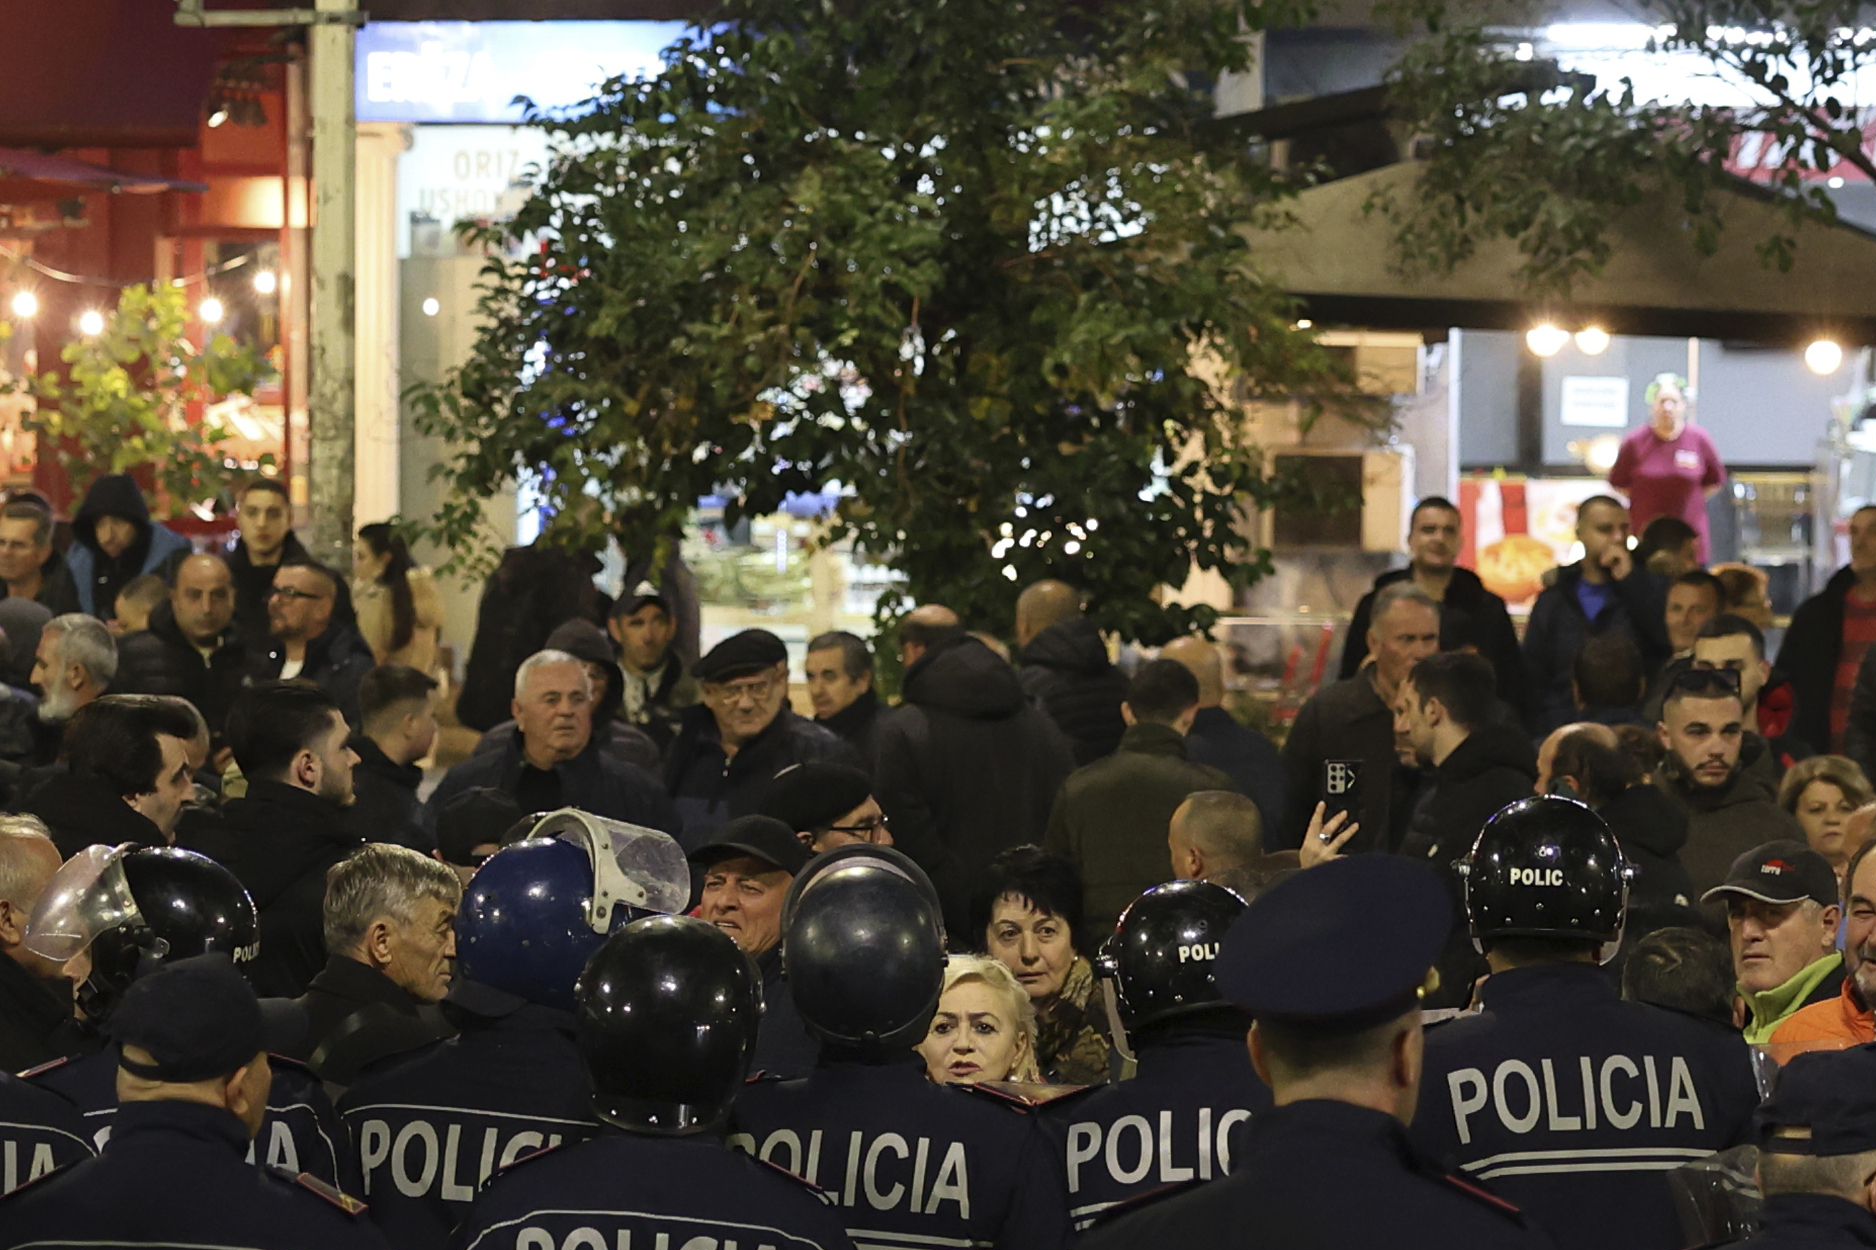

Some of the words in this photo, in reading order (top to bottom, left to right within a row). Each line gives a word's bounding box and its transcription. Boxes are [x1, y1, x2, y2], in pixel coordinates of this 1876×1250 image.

[1510, 867, 1563, 886] POLIC
[1178, 942, 1220, 963] POLI
[1447, 1054, 1705, 1145] POLICIA
